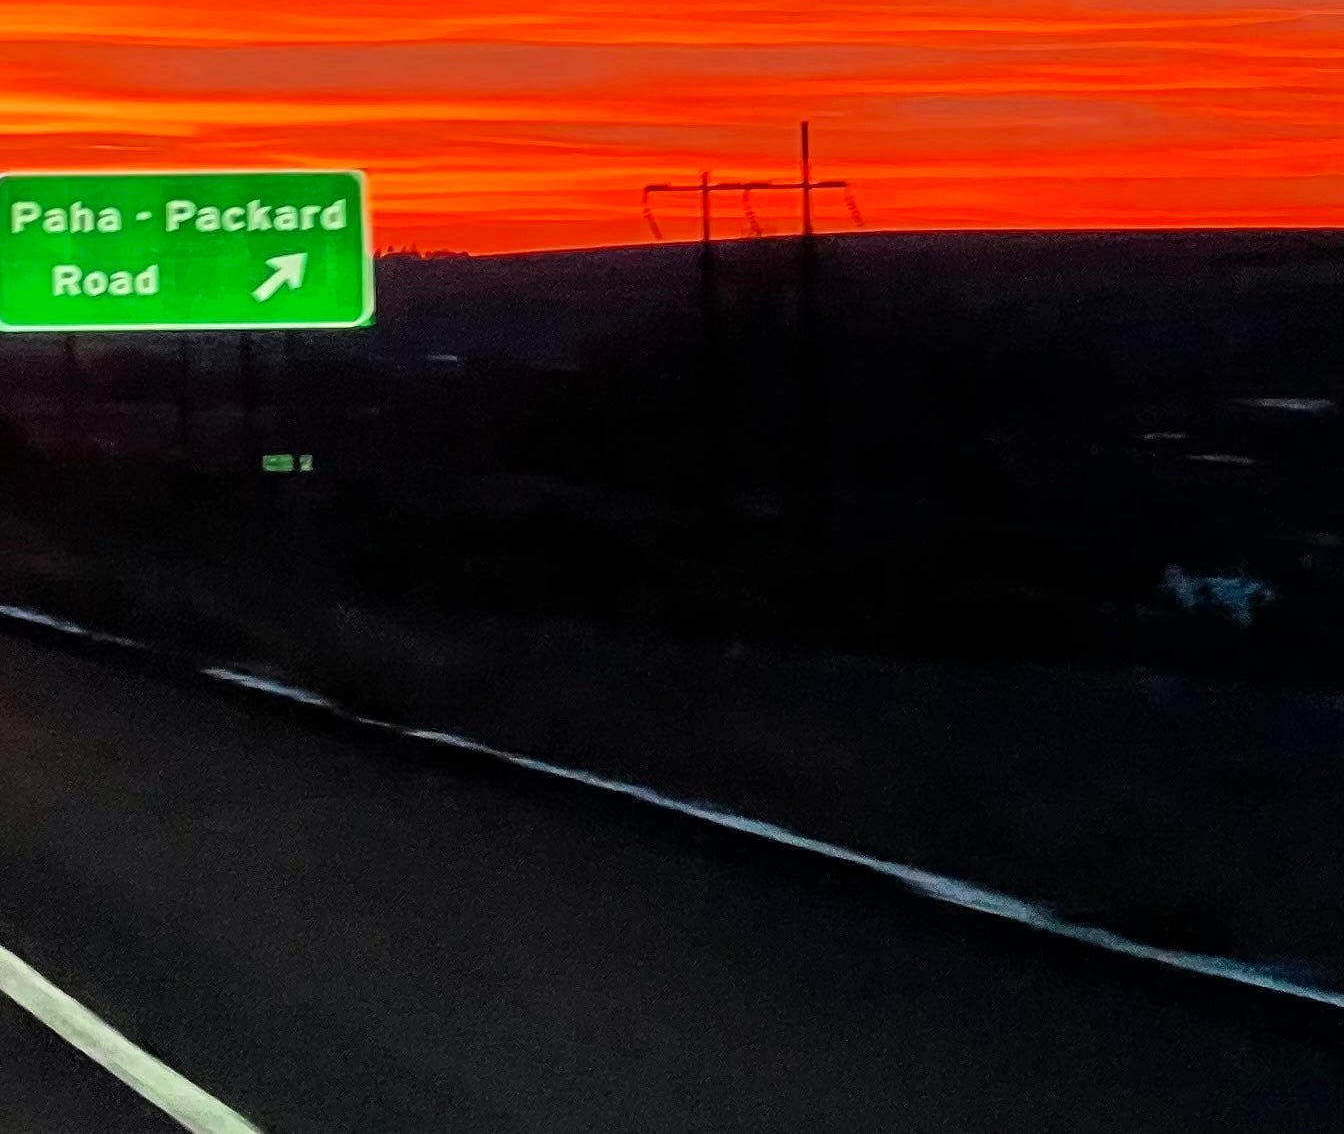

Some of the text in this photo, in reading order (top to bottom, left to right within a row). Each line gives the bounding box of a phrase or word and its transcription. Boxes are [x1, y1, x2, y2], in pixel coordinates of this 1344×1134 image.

[11, 201, 123, 234] Paha
[165, 199, 347, 233] Packard
[51, 264, 160, 297] Road
